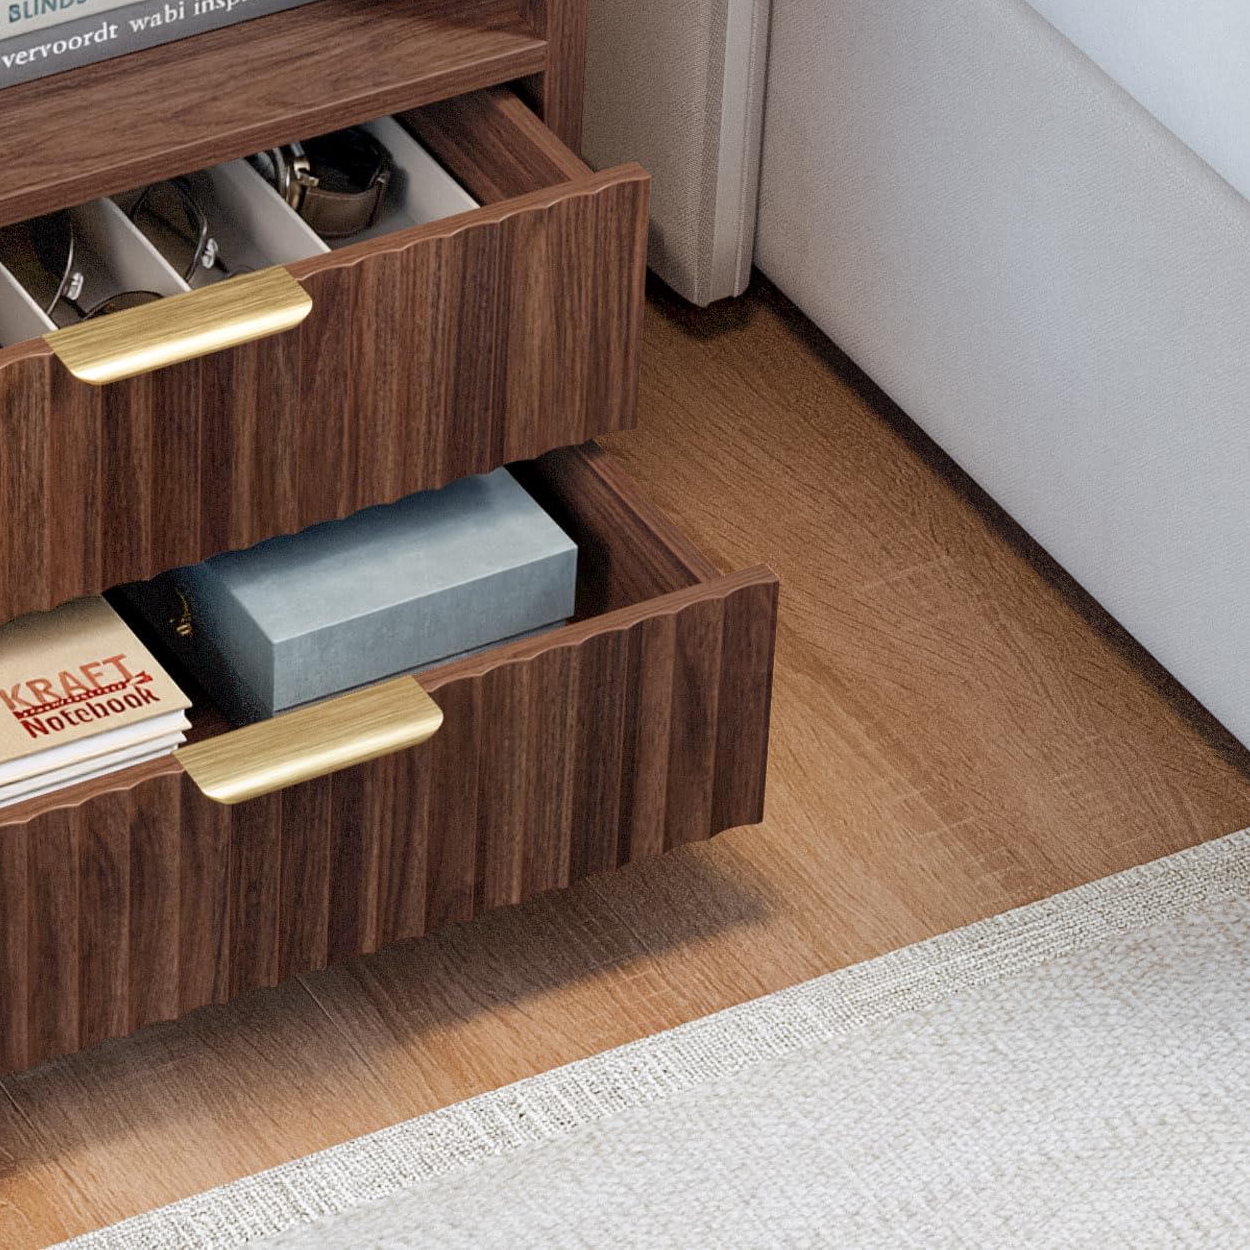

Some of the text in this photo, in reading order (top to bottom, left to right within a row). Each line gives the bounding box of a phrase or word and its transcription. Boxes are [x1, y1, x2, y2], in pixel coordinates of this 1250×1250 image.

[1, 21, 119, 69] vervoordt
[128, 1, 186, 34] wabi
[19, 685, 162, 739] Notebook
